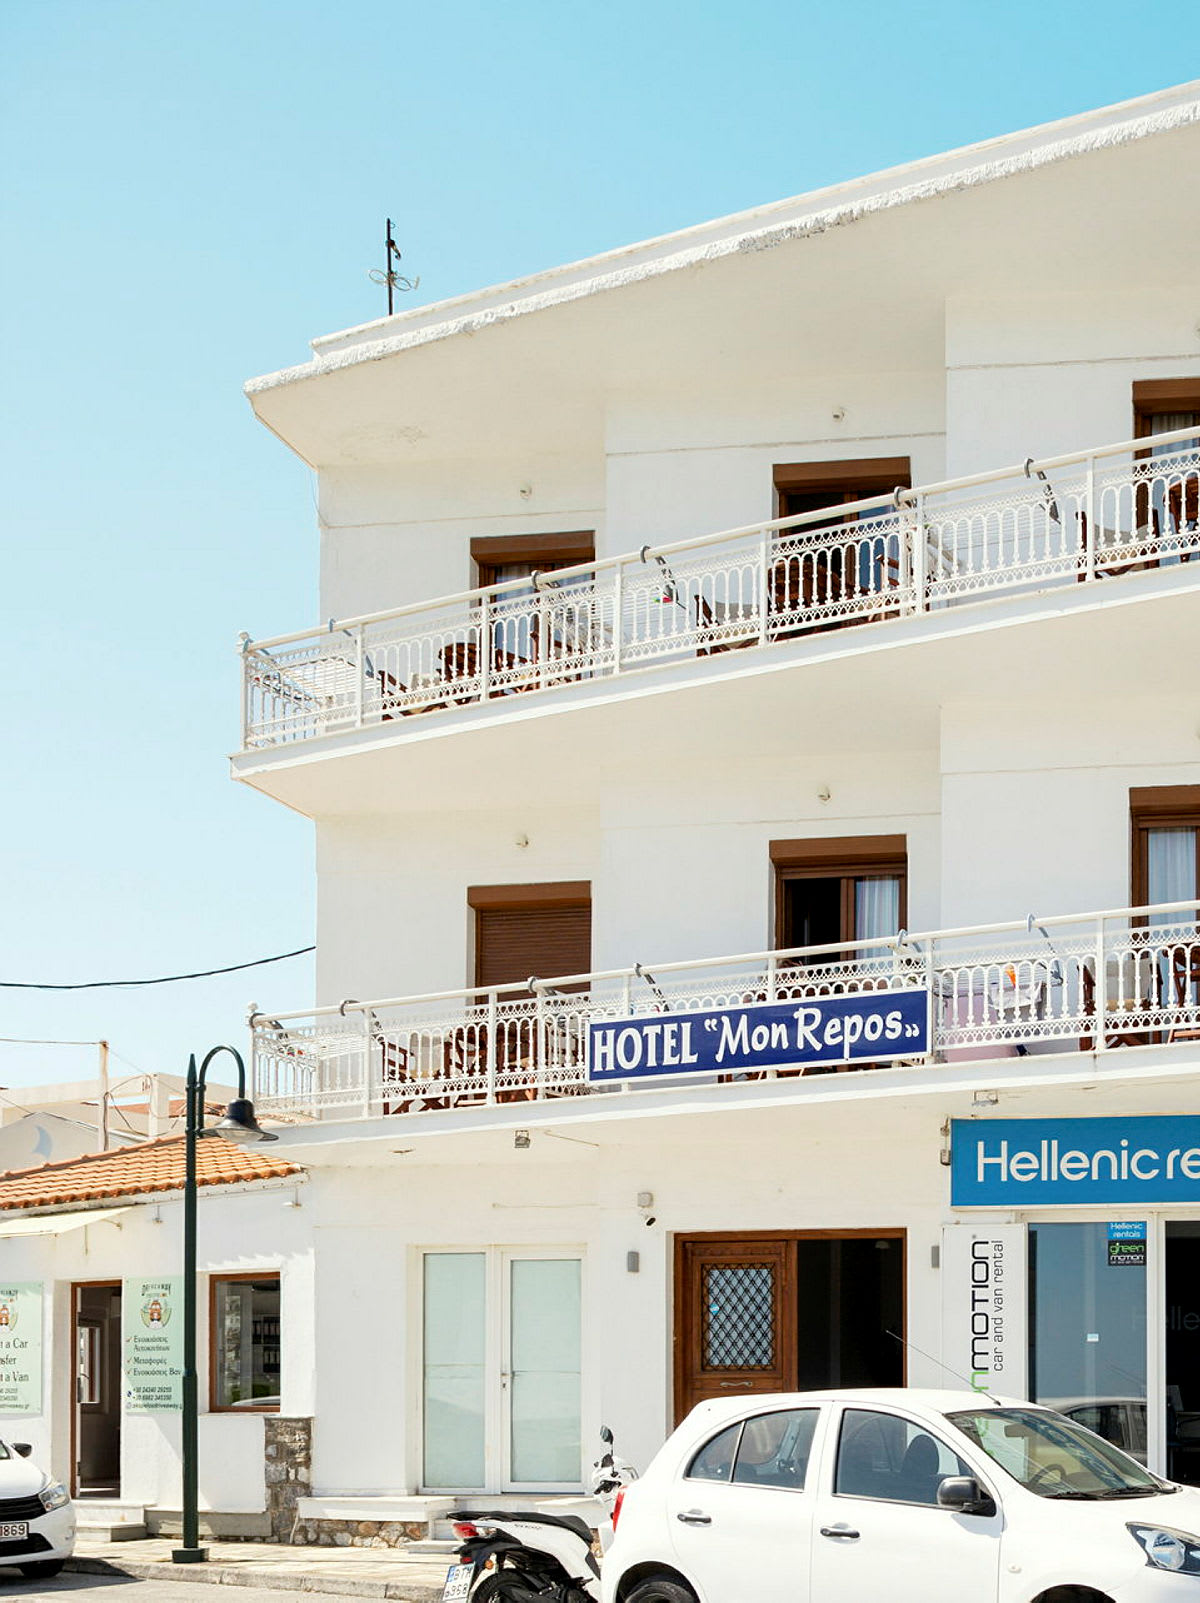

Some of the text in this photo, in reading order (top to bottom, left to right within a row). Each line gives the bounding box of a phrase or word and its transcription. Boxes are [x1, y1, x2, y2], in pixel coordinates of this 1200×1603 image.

[593, 1021, 698, 1072] HOTEL
[977, 1139, 1159, 1183] Hellenic
[991, 1240, 1004, 1372] car and van rental
[12, 1338, 28, 1349] Car
[12, 1370, 29, 1381] Van
